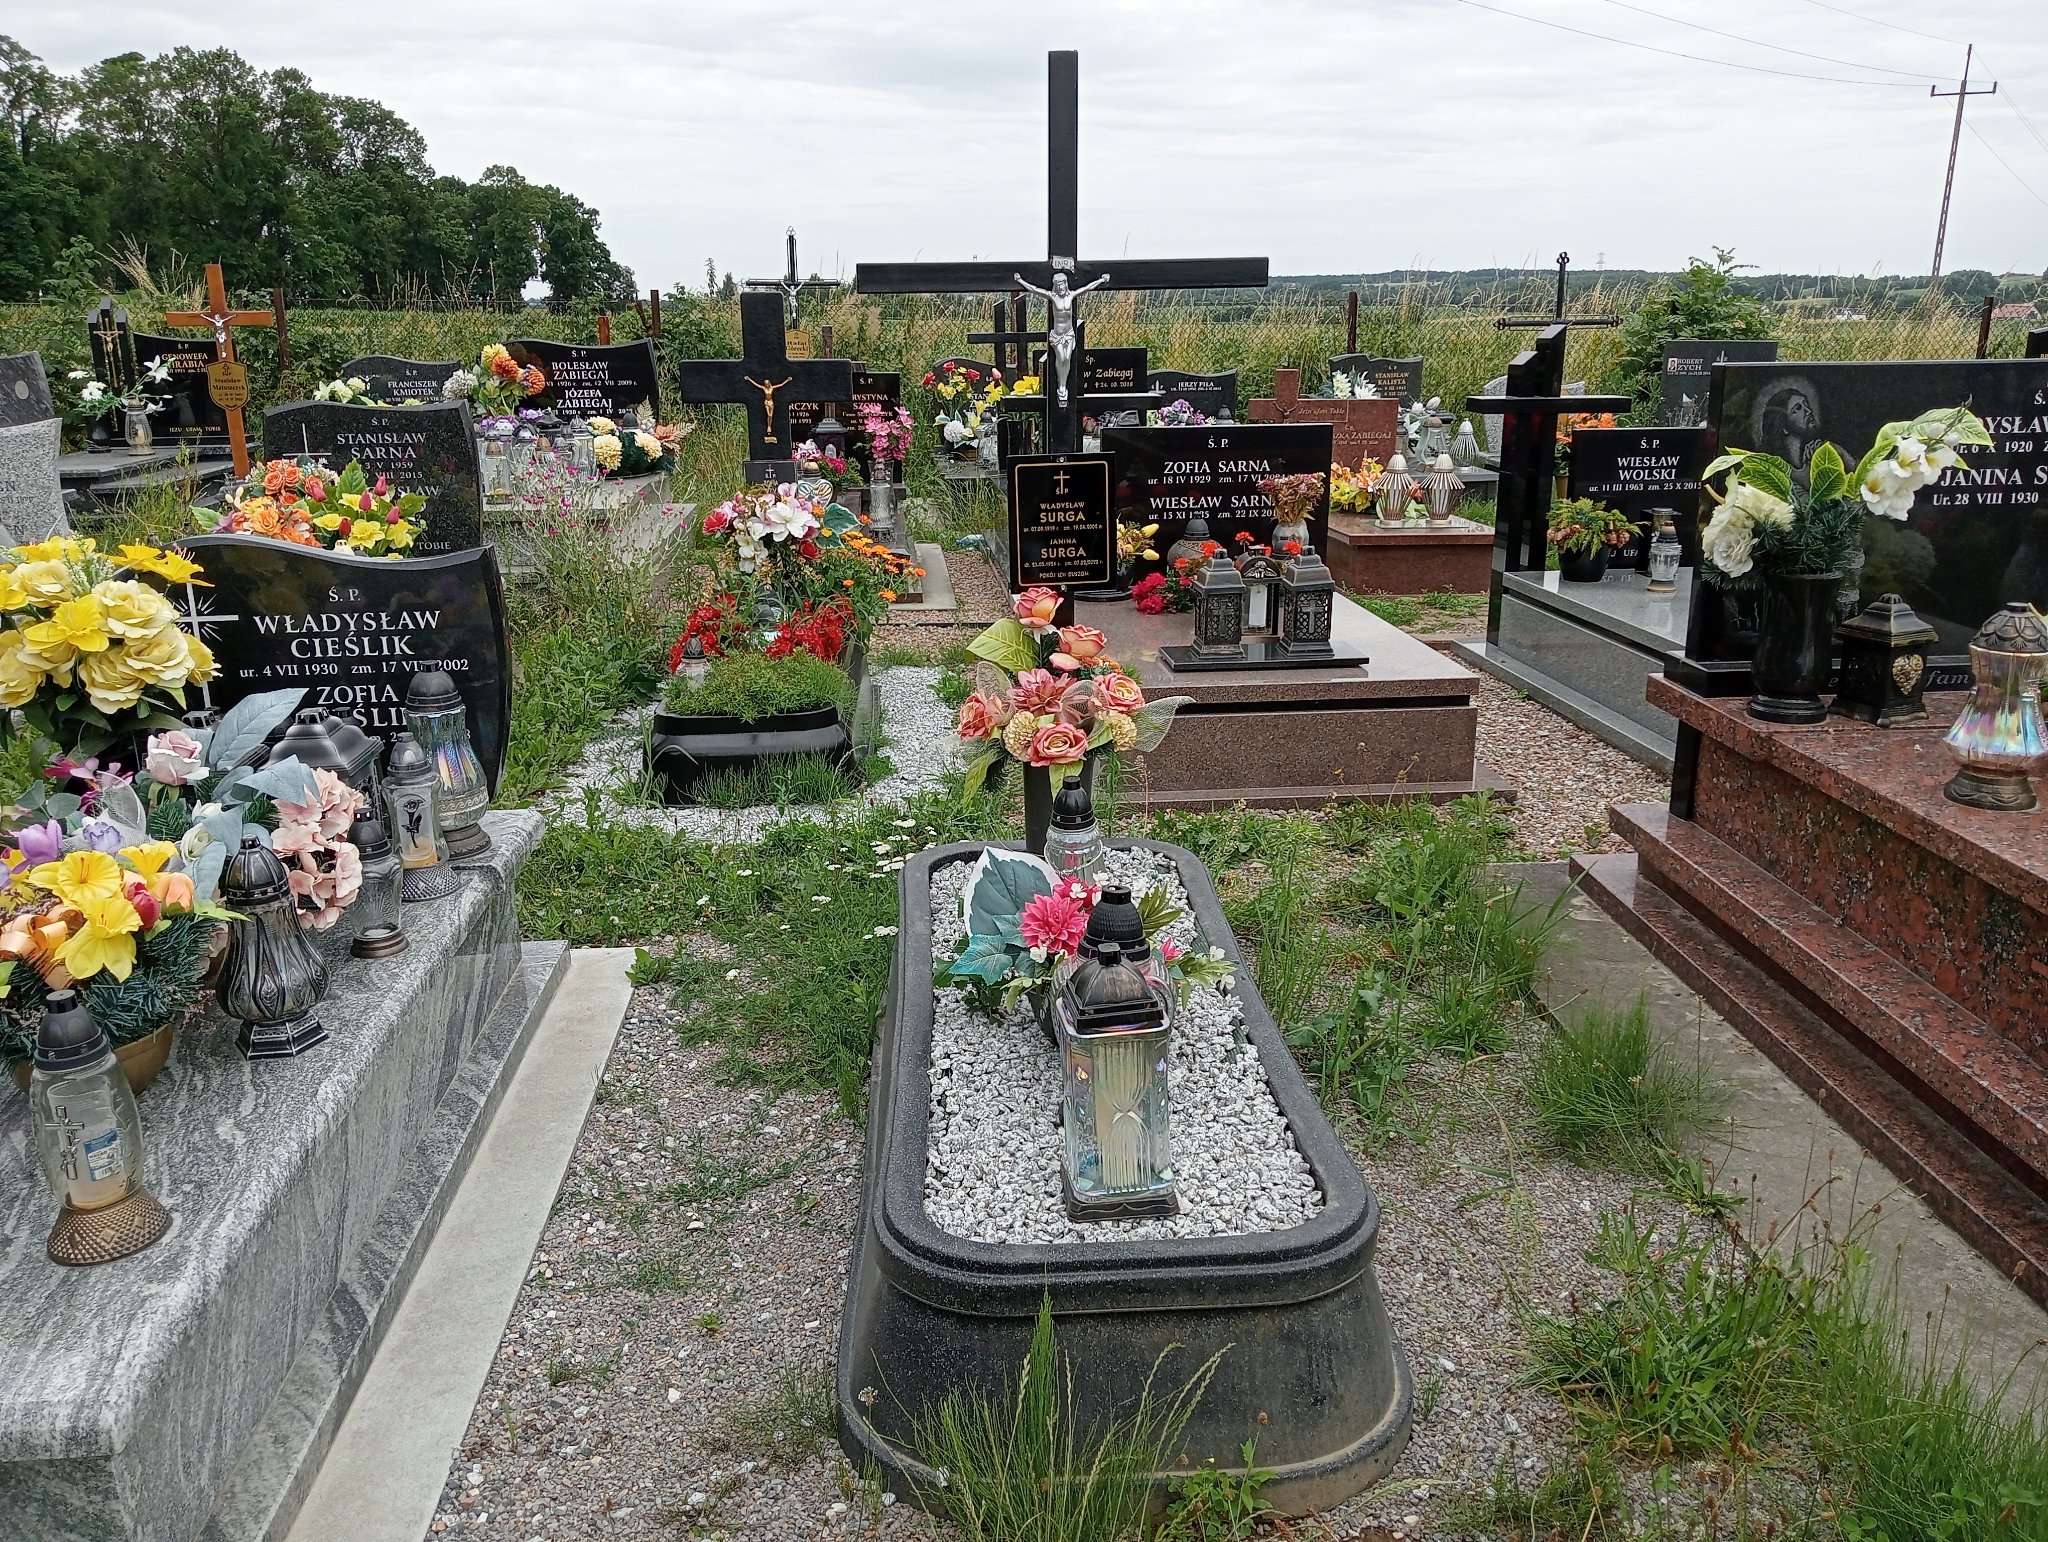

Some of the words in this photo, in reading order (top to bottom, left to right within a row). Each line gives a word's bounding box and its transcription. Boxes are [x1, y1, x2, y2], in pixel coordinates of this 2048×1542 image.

[552, 361, 609, 370] BOLESŁAW
[553, 370, 609, 380] ZABIEGAJ
[1095, 368, 1134, 380] Zabiegaj
[388, 380, 438, 388] FRANCISZEK
[1178, 381, 1198, 391] JERZY
[393, 388, 435, 396] KMIOTEK
[564, 388, 602, 399] JÓZEFA
[556, 398, 612, 408] ZABIEGAJ
[337, 432, 427, 445] STANISŁAW
[1207, 435, 1218, 448] Ś.
[1220, 438, 1229, 448] P.
[1640, 437, 1649, 449] Ś.
[1652, 439, 1660, 448] P.
[351, 446, 417, 460] SARNA
[2004, 441, 2033, 453] 1920
[391, 461, 413, 469] 1959
[1163, 460, 1211, 474] ZOFIA
[1218, 460, 1271, 473] SARNA
[1617, 455, 1680, 467] WIESŁAW
[400, 471, 423, 479] 2015
[1163, 476, 1173, 484] 18
[1175, 476, 1186, 484] IV
[1189, 475, 1211, 484] 1929
[1238, 474, 1248, 483] 17
[1618, 468, 1676, 481] WOLSKI
[1941, 468, 2023, 487] JANINA
[1625, 483, 1644, 491] 1963
[1663, 482, 1673, 490] 25
[1675, 482, 1682, 490] X
[1149, 495, 1223, 509] WIESŁAW
[1933, 494, 1950, 506] Ur.
[1954, 493, 1970, 505] 28
[1977, 492, 2003, 504] VIII
[2010, 491, 2039, 504] 1930
[1040, 511, 1085, 522] SURGA
[1163, 511, 1173, 519] 15
[1175, 511, 1186, 519] XI
[1235, 510, 1246, 518] 22
[1248, 509, 1259, 518] IX
[417, 541, 452, 551] TOBIE
[1041, 547, 1086, 558] SURGA
[329, 586, 344, 603] Ś.
[347, 588, 361, 602] P.
[253, 609, 441, 635] WŁADYSŁAW
[290, 633, 416, 659] CIEŚLIK
[239, 667, 259, 678] ur.
[263, 663, 272, 677] 4
[276, 664, 300, 677] VII
[305, 663, 339, 676] 1930
[351, 664, 376, 674] zm.
[382, 661, 397, 673] 17
[436, 659, 469, 671] 2002
[316, 684, 400, 705] ZOFIA
